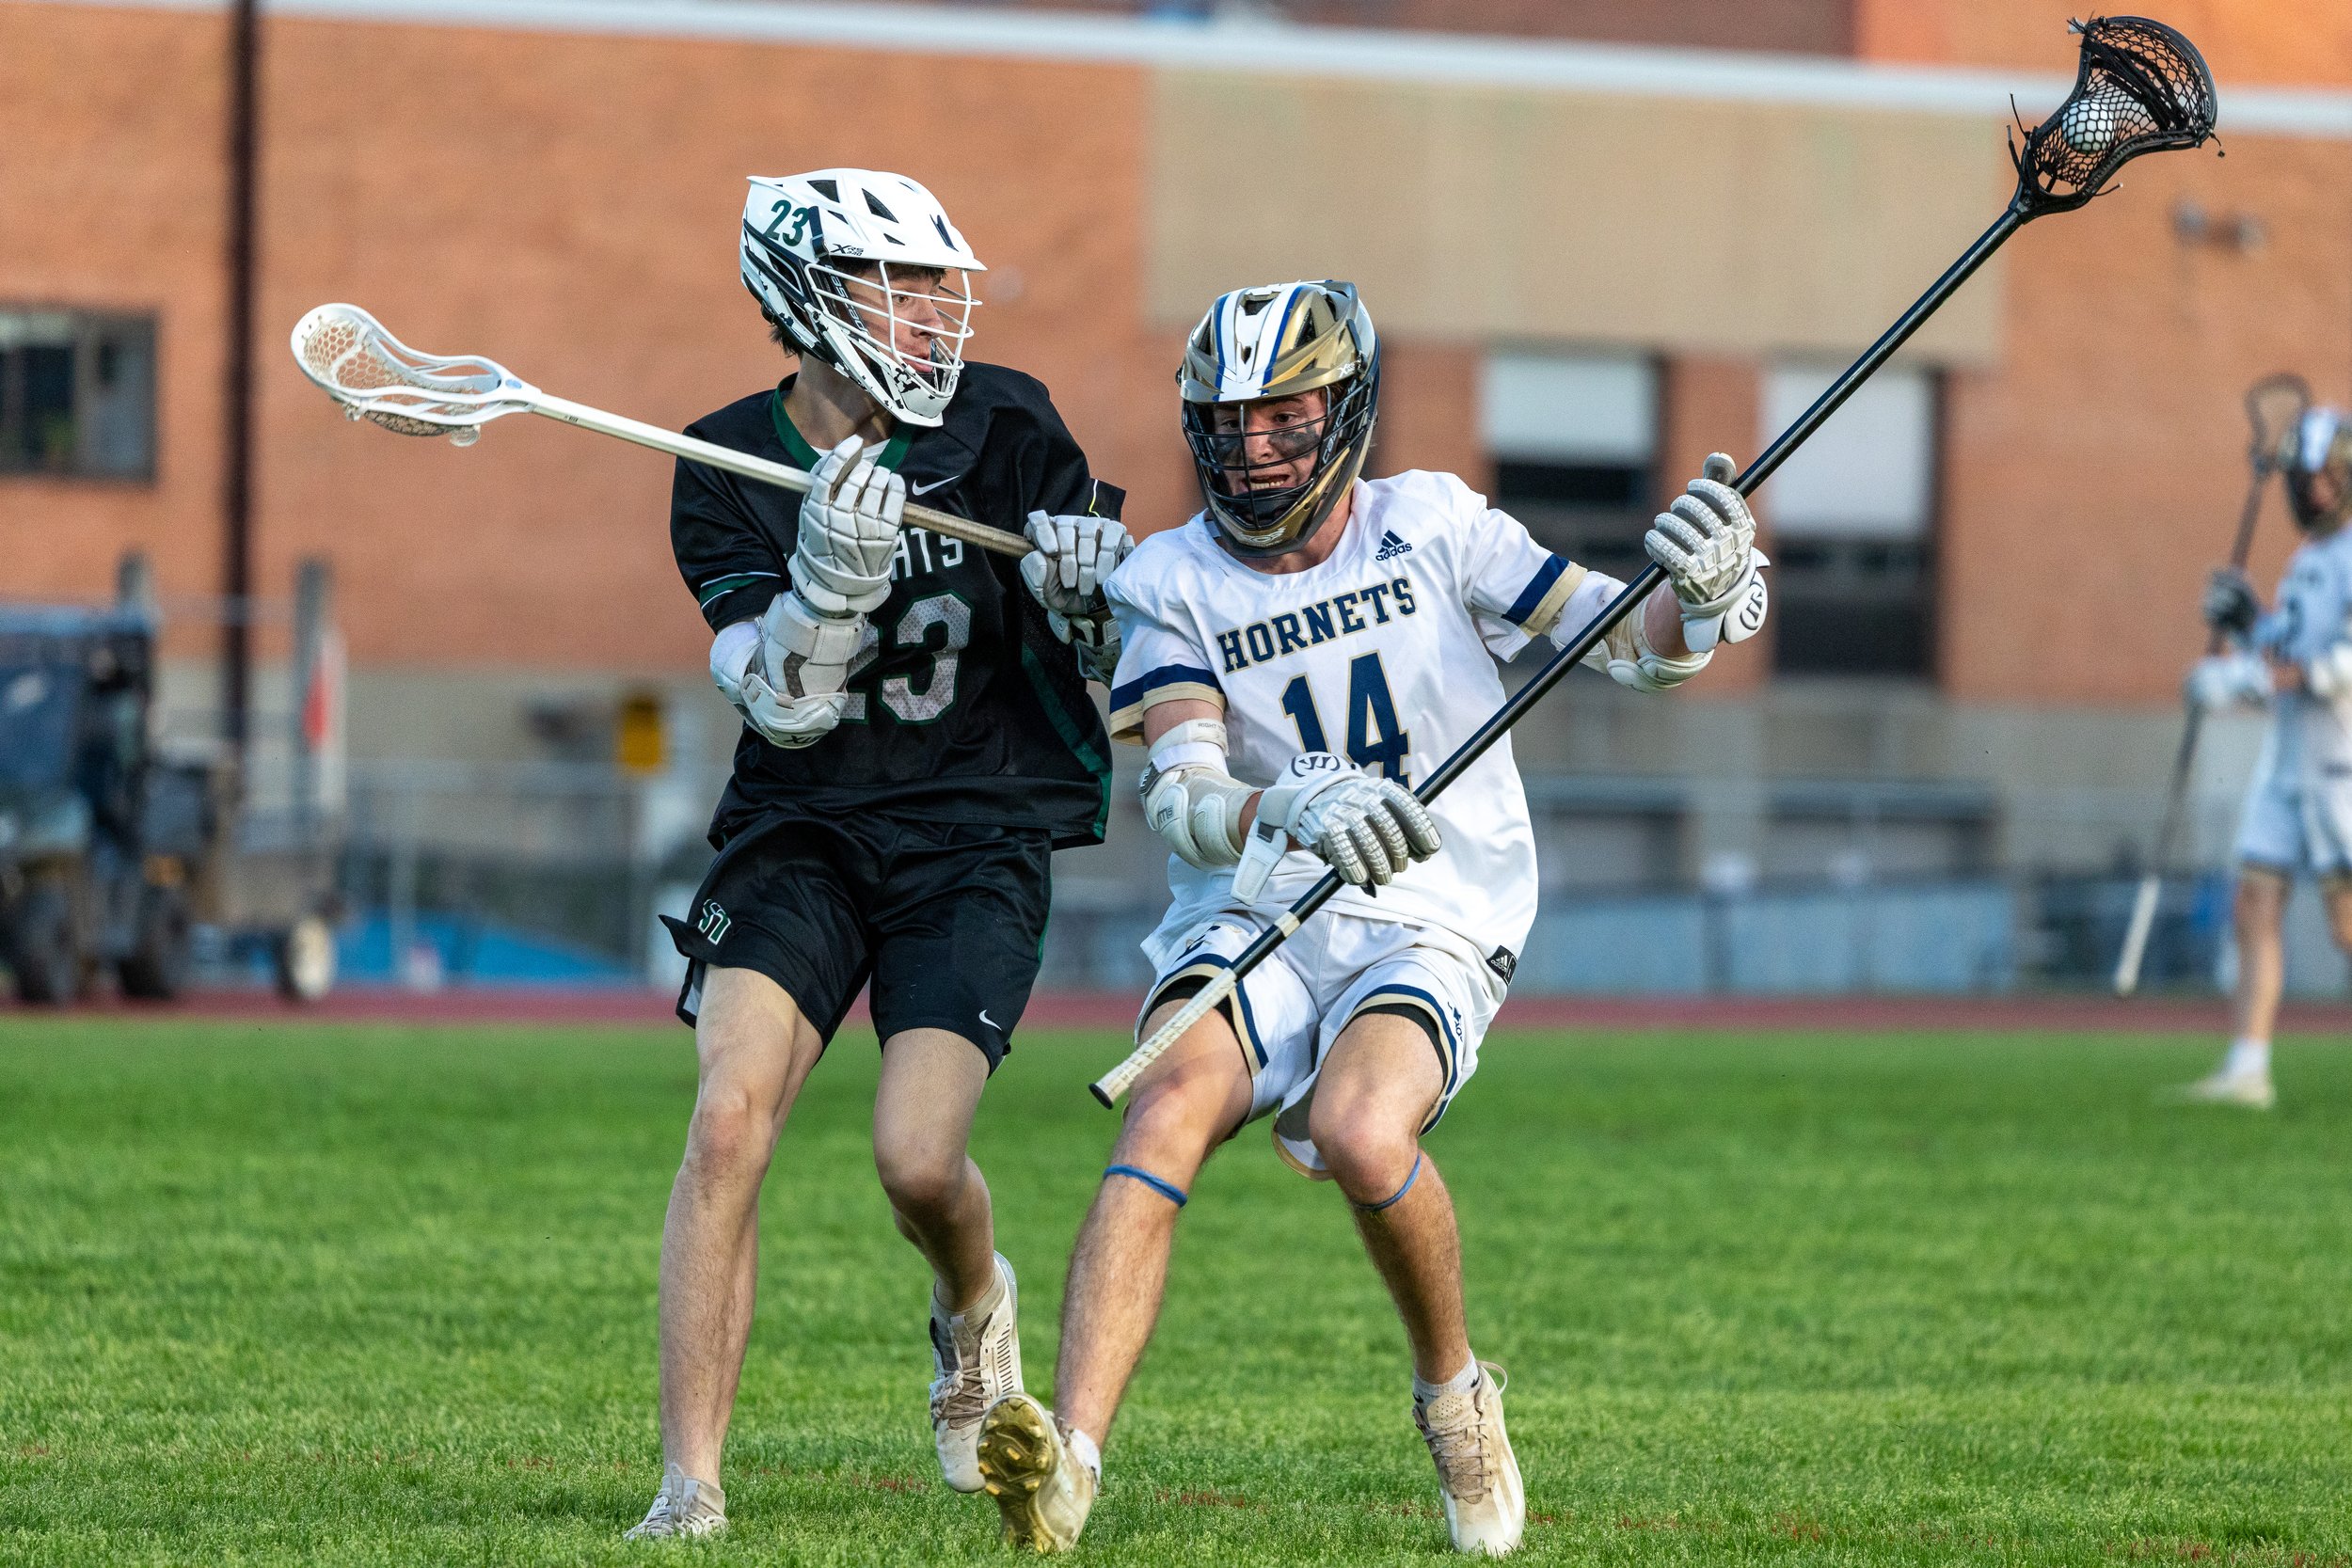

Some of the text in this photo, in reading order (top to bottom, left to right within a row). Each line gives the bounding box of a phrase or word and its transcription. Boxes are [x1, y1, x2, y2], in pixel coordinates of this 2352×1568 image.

[762, 199, 810, 247] 23
[1375, 543, 1412, 562] adidas
[1216, 575, 1418, 675] HORNETS
[1279, 649, 1412, 790] 14
